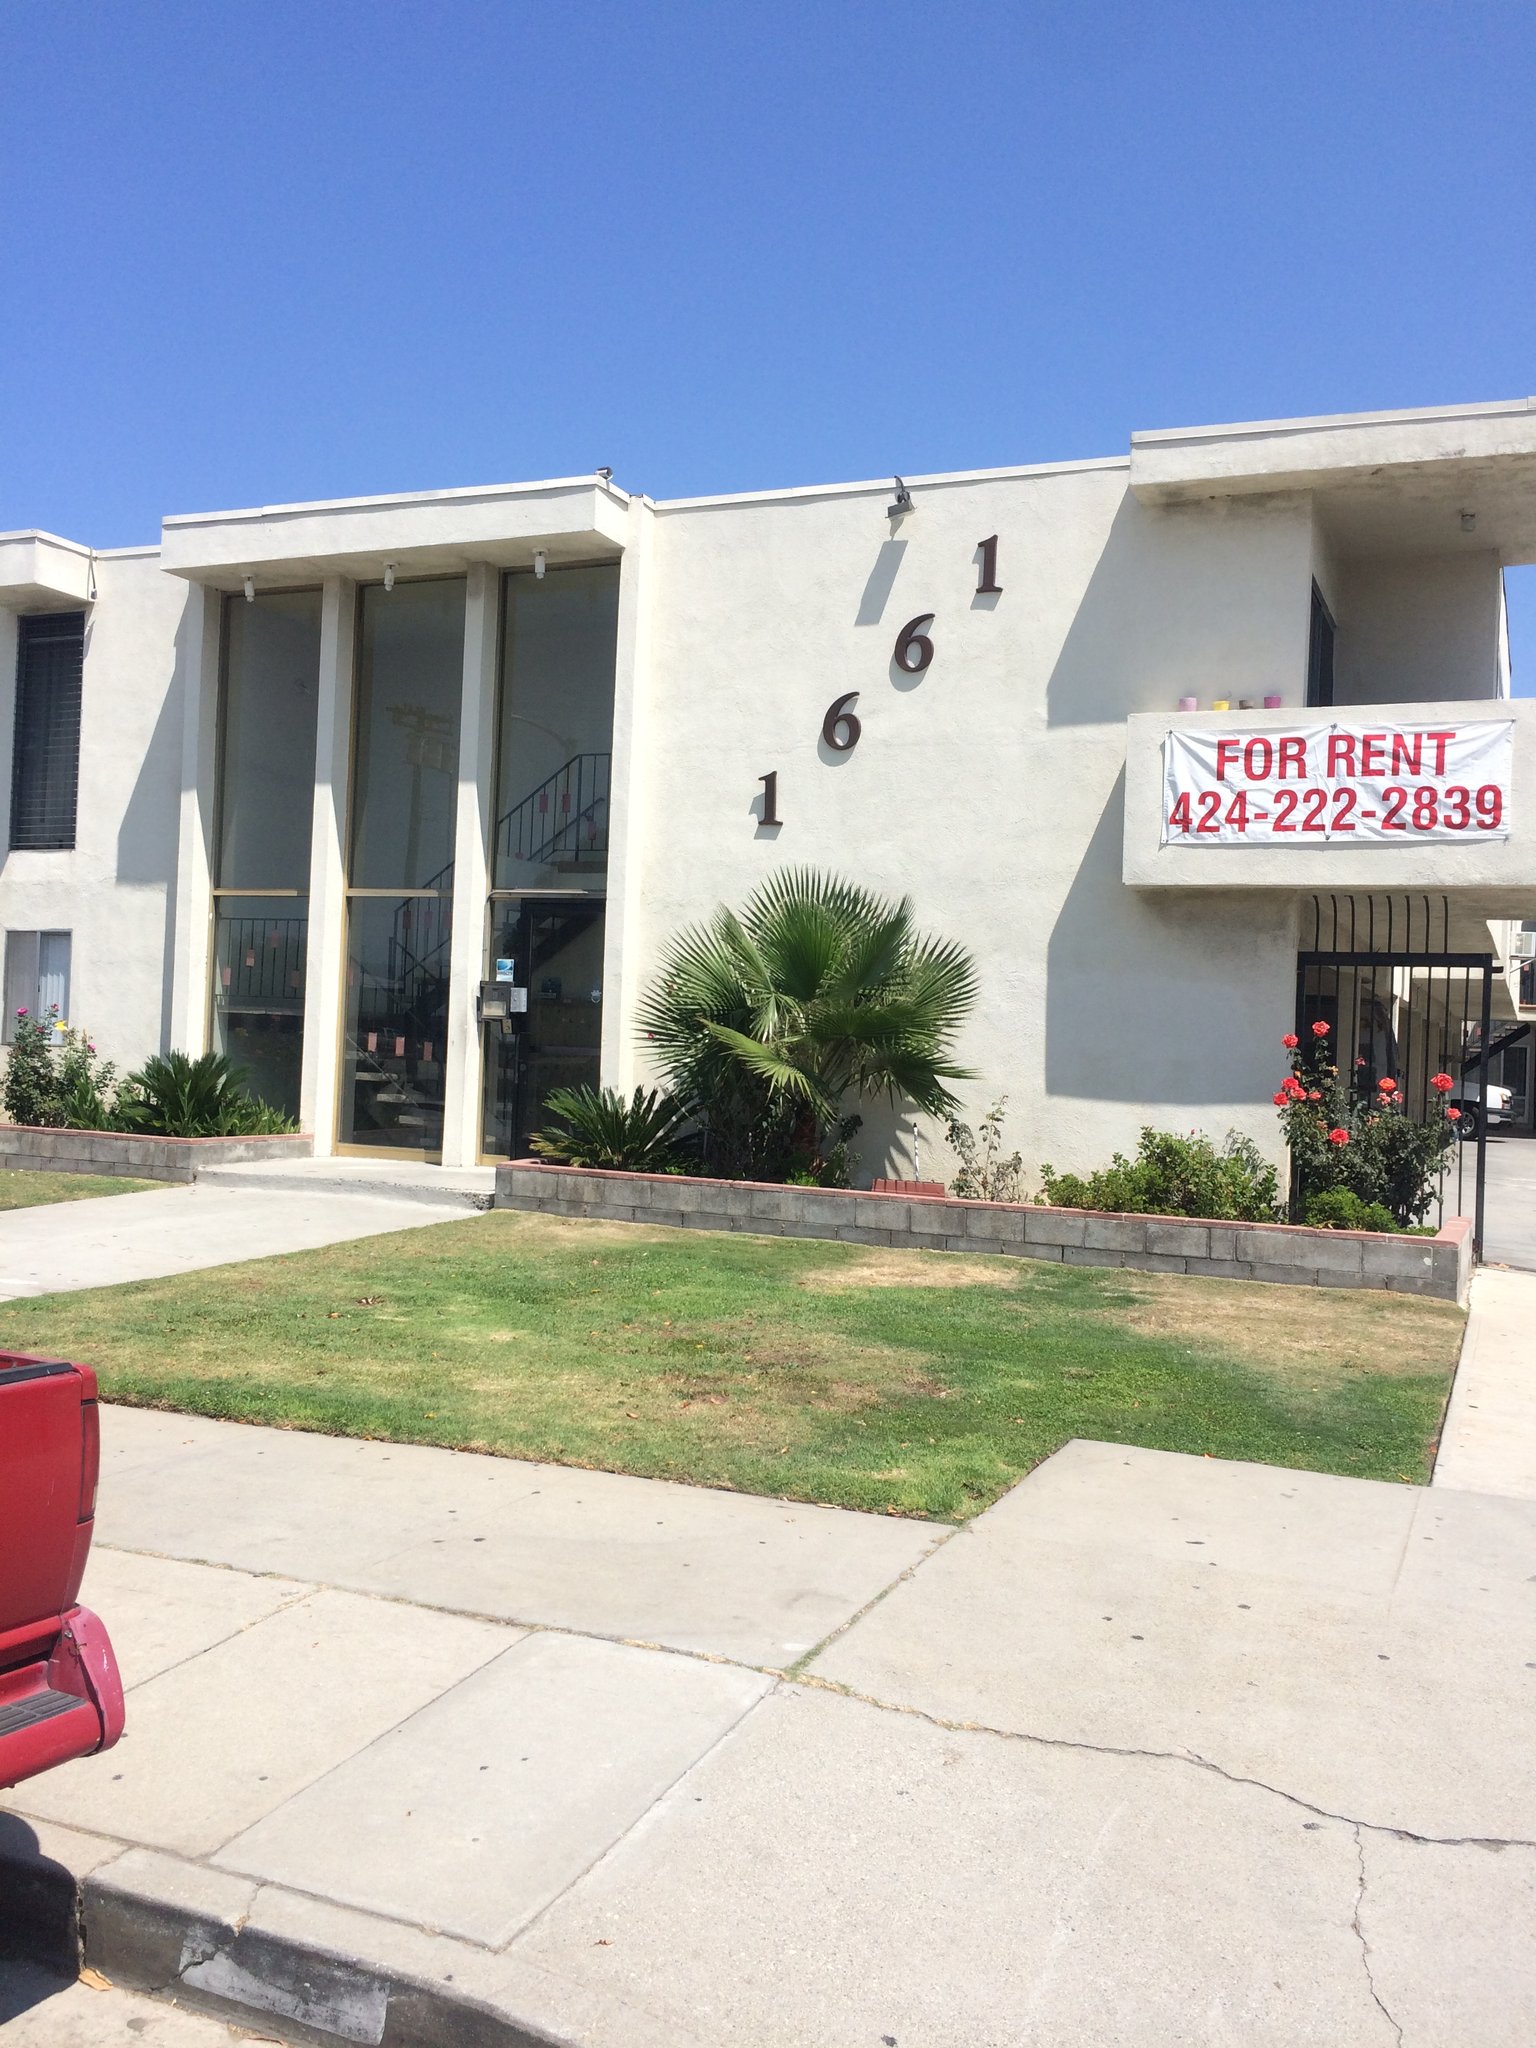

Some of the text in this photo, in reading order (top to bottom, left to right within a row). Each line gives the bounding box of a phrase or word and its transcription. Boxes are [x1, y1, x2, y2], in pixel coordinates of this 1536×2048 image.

[1216, 732, 1457, 781] FOR RENT
[1169, 784, 1503, 833] 424-222-2839
